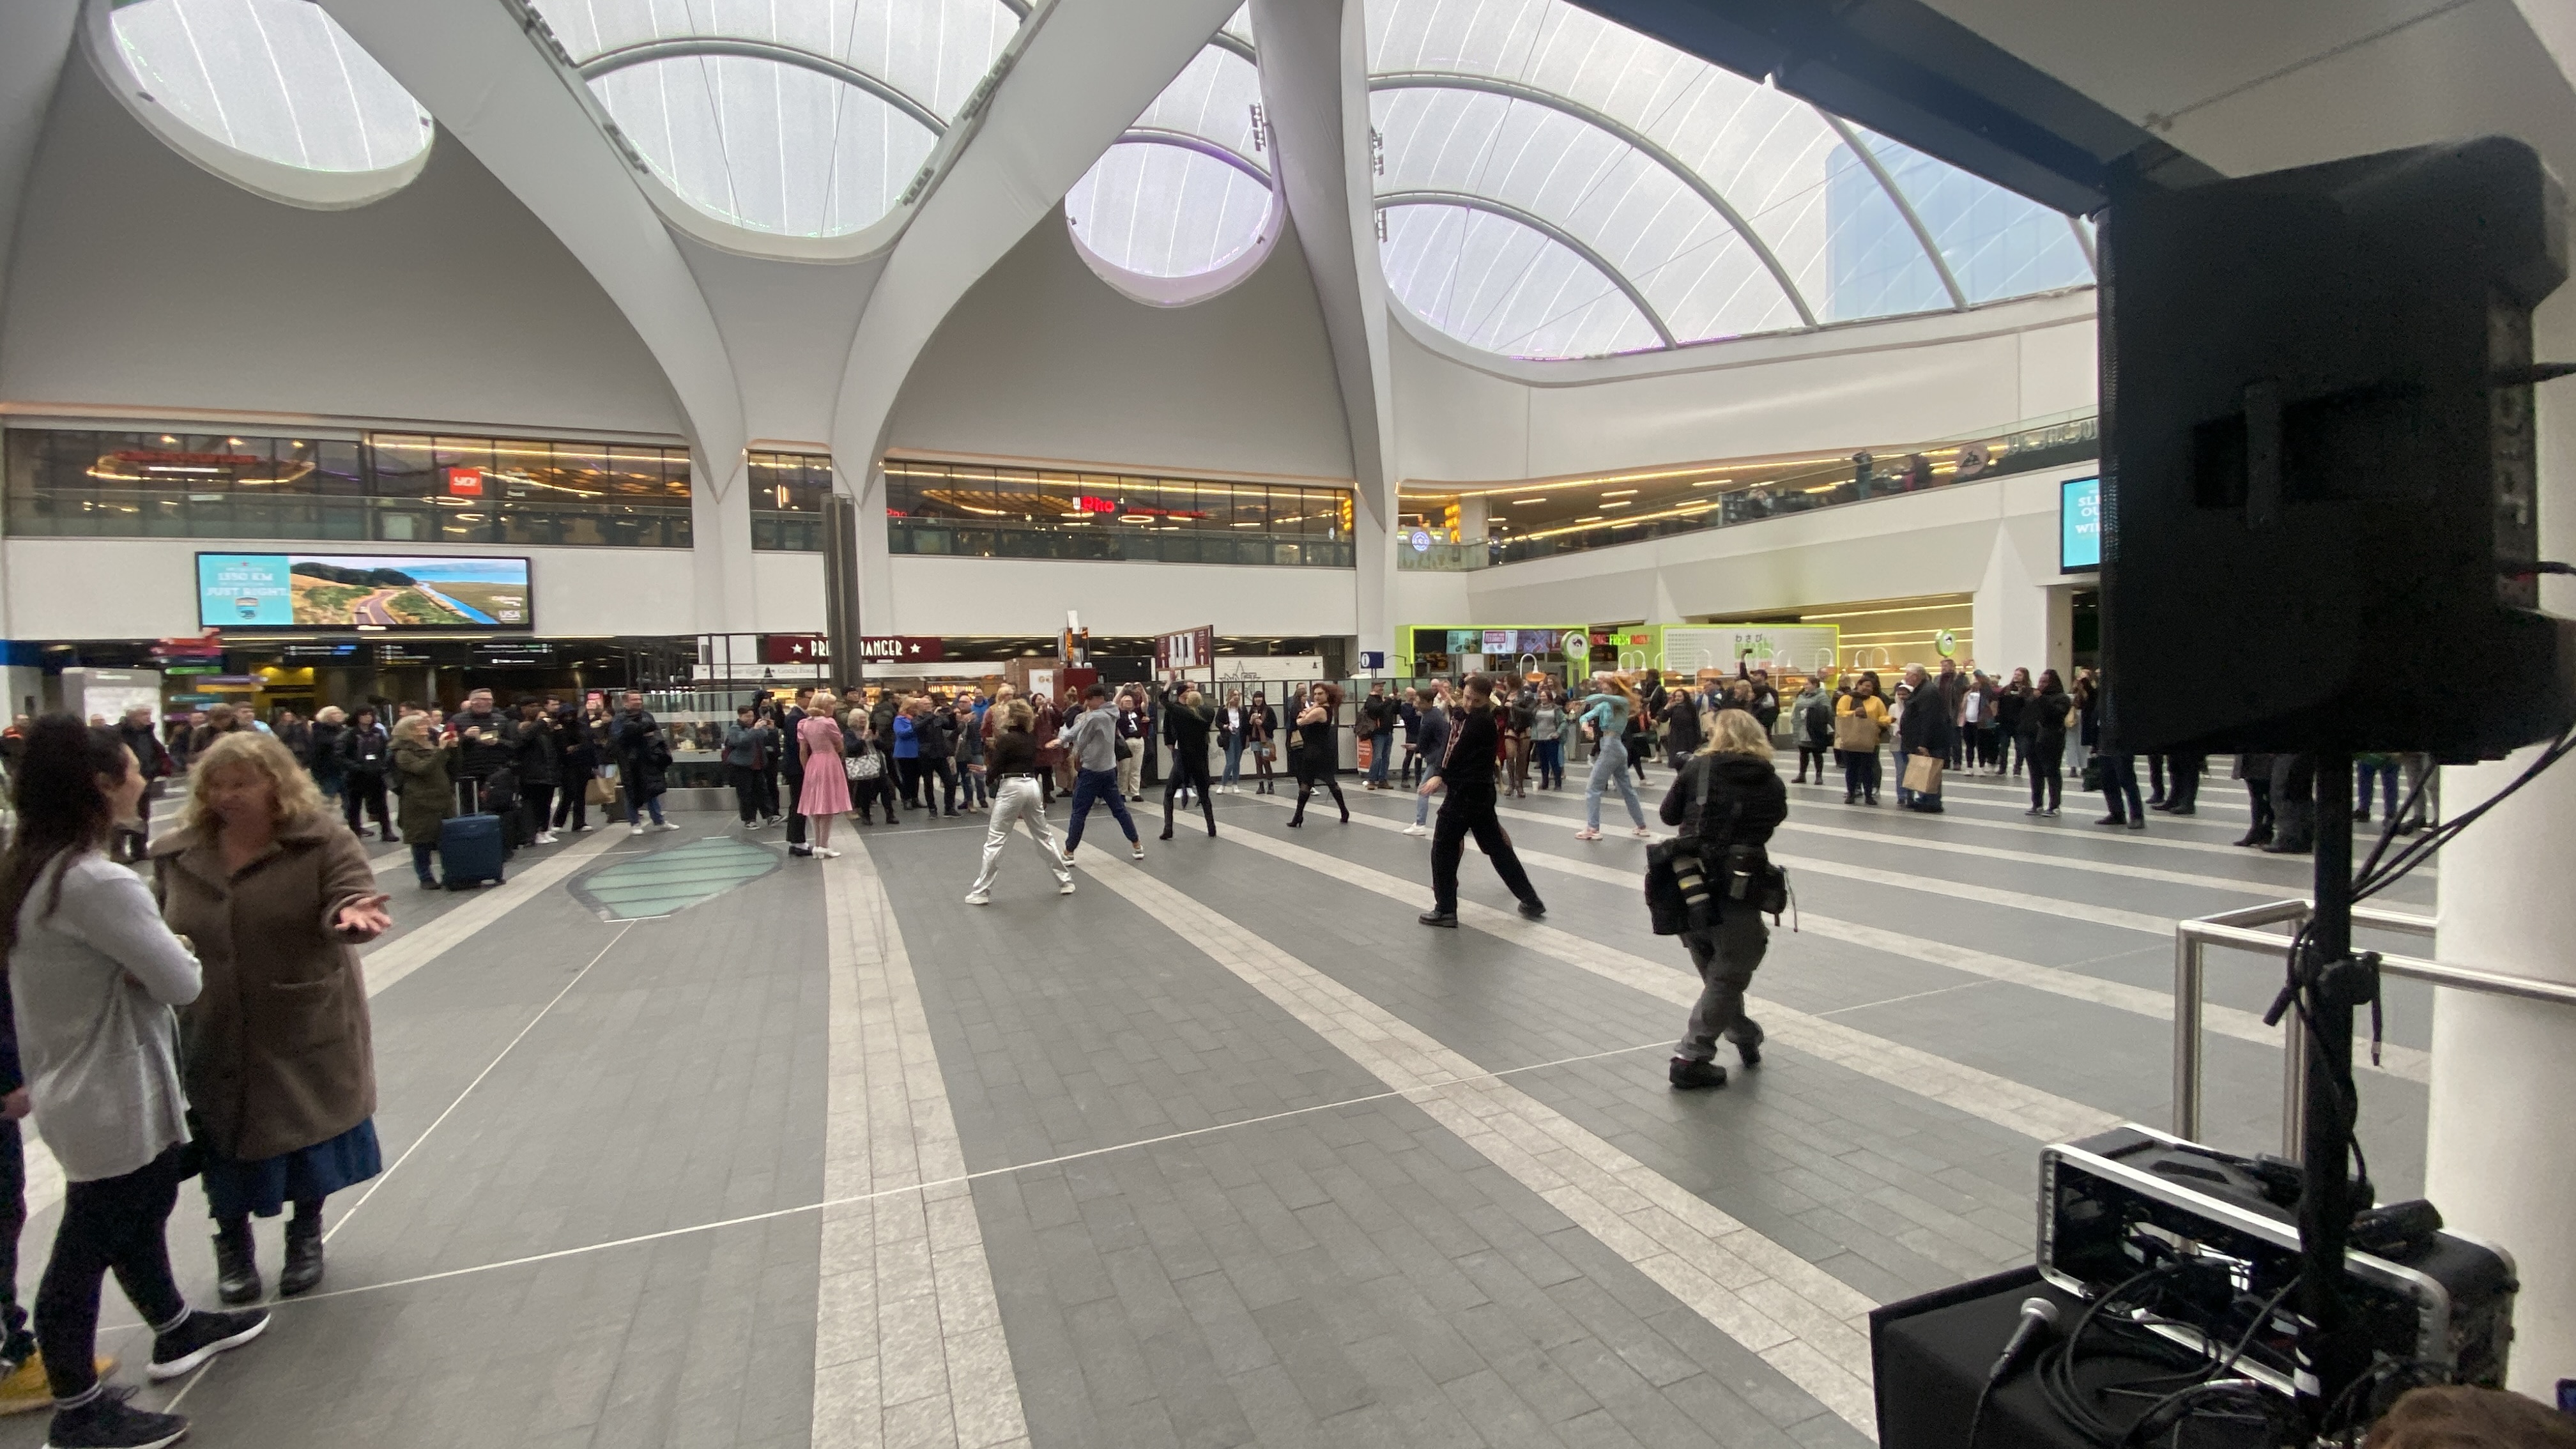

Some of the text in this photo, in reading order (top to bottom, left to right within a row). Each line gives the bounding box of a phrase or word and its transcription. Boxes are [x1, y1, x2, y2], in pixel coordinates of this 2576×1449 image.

[1082, 496, 1115, 513] Pho
[206, 587, 240, 596] JUST
[1609, 634, 1630, 645] FRESH
[1735, 633, 1763, 643] わさび
